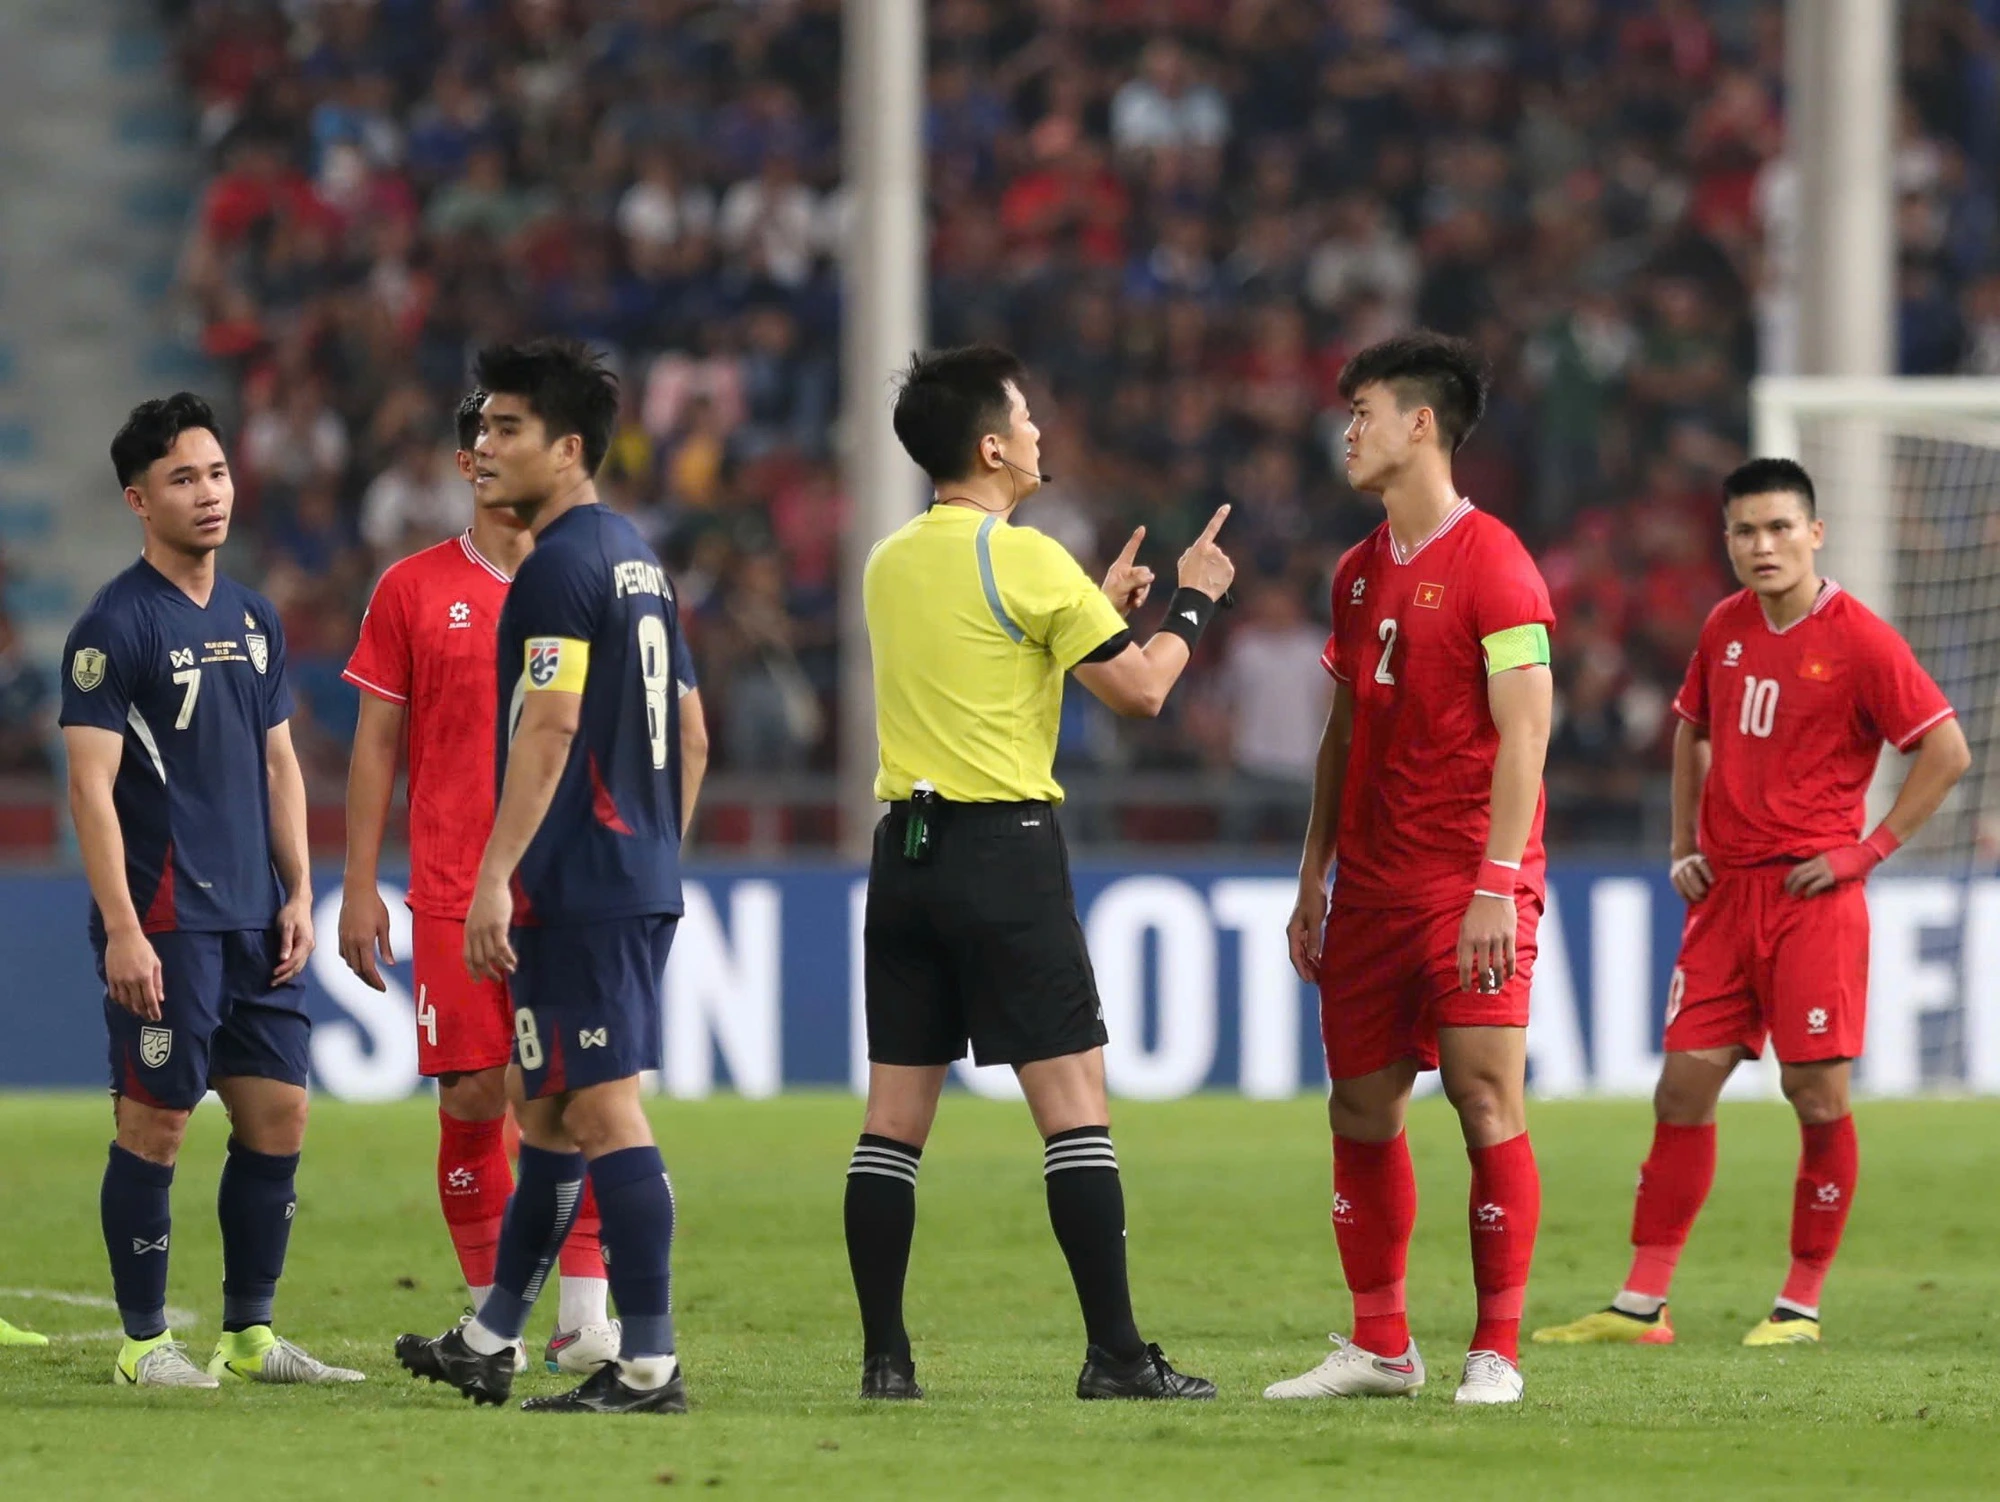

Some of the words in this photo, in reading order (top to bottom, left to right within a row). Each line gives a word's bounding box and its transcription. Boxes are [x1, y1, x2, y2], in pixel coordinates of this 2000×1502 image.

[1374, 618, 1397, 685] 2
[172, 668, 201, 730] 7
[637, 615, 670, 770] 8
[1739, 674, 1780, 738] 10
[418, 983, 438, 1046] 4
[515, 1007, 543, 1070] 8
